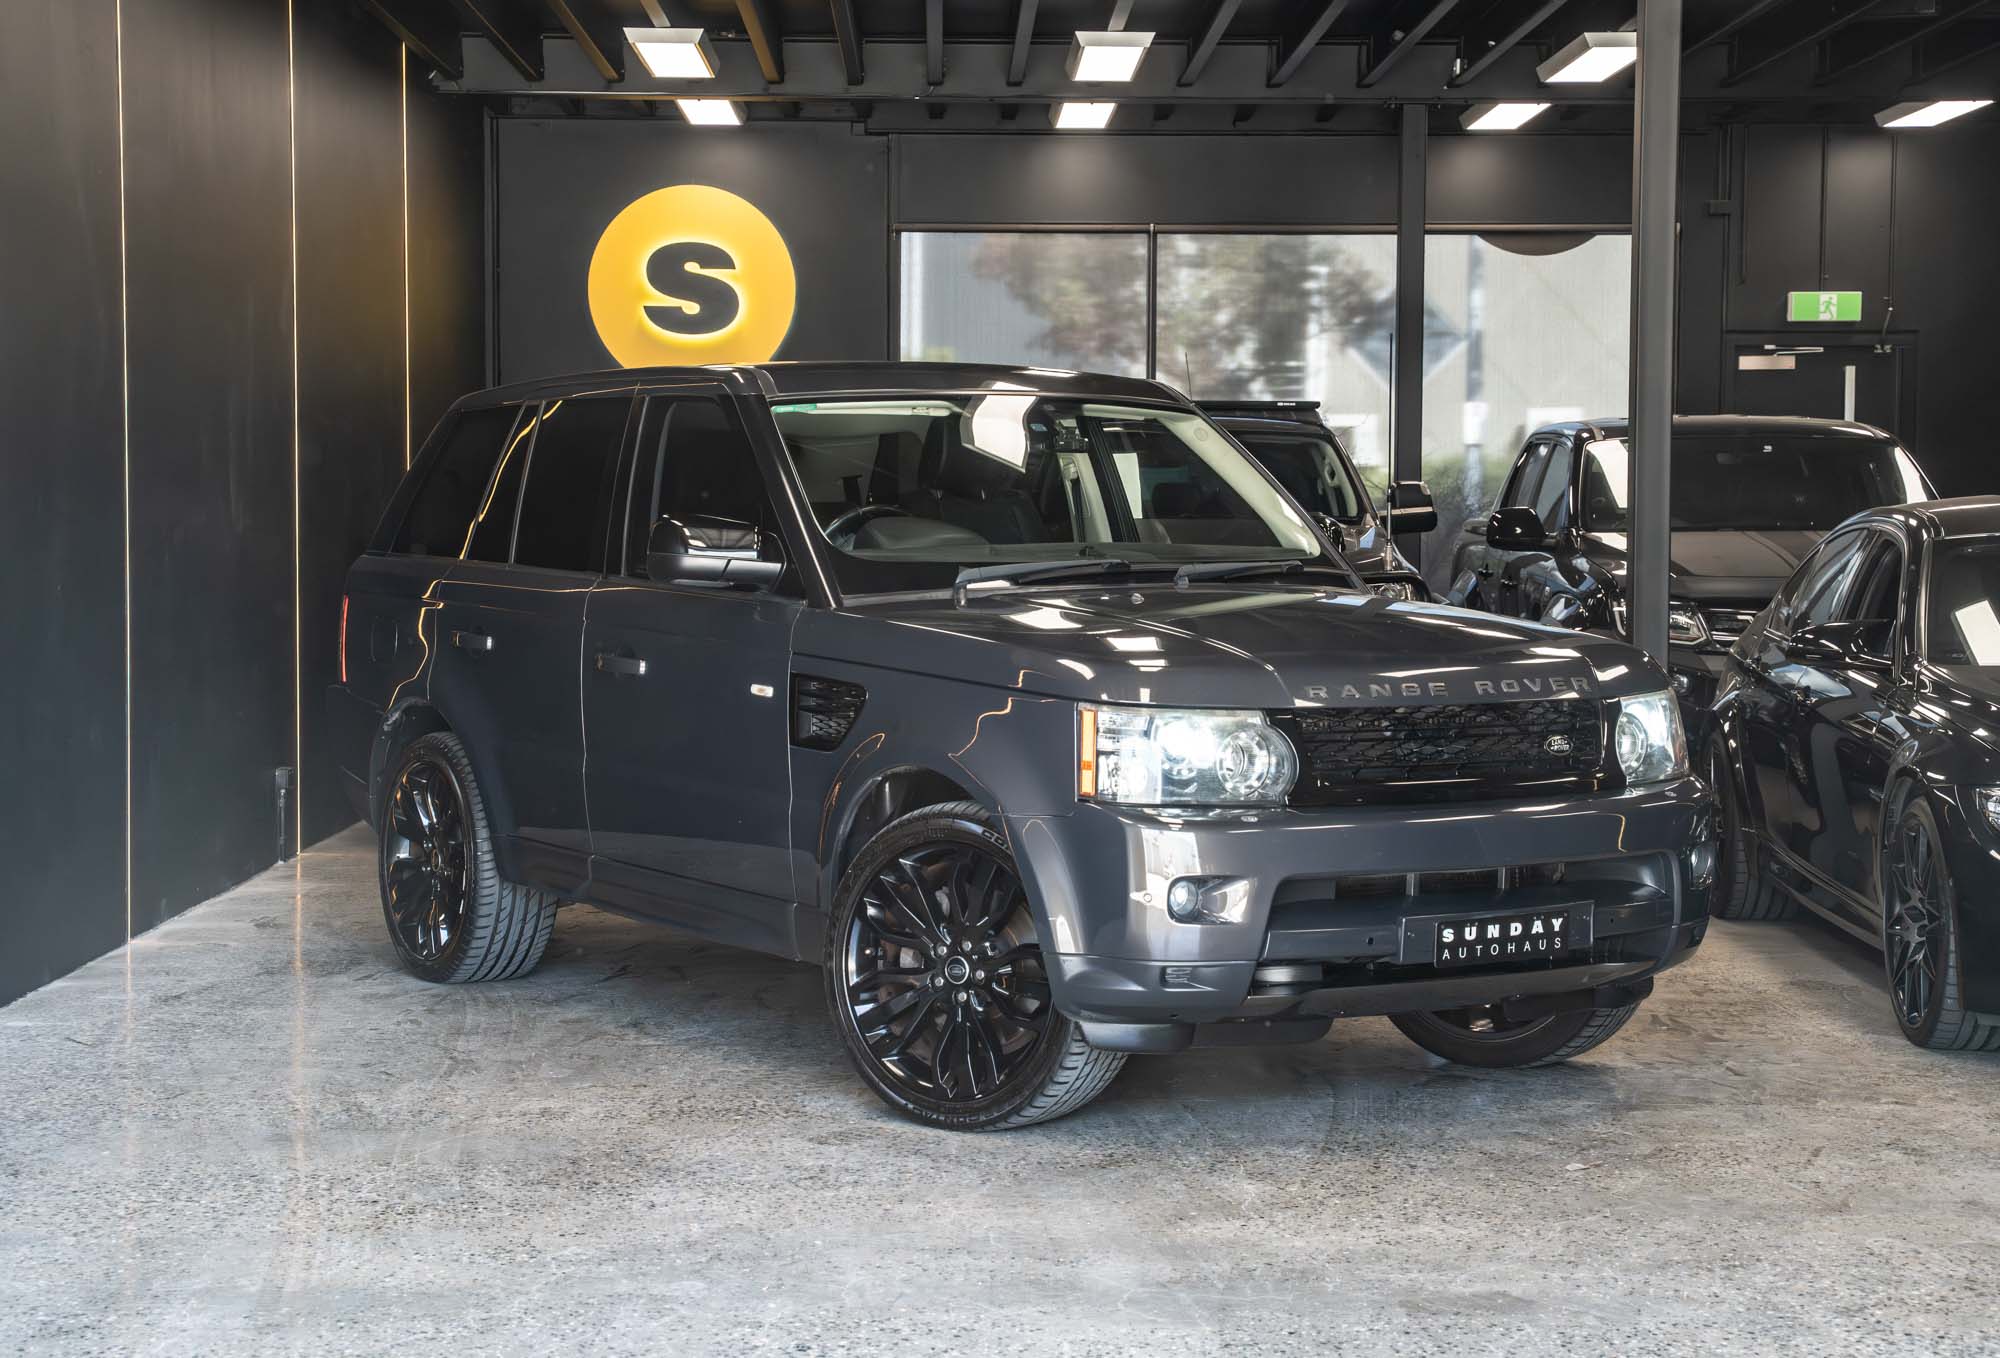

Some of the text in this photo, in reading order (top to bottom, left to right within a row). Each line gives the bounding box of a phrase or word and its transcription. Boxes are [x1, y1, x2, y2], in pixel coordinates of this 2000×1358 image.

[643, 241, 739, 335] S
[1308, 676, 1592, 699] RANGE ROVER
[1441, 917, 1564, 943] SUNDAY
[1442, 937, 1561, 960] AUTOHAUS
